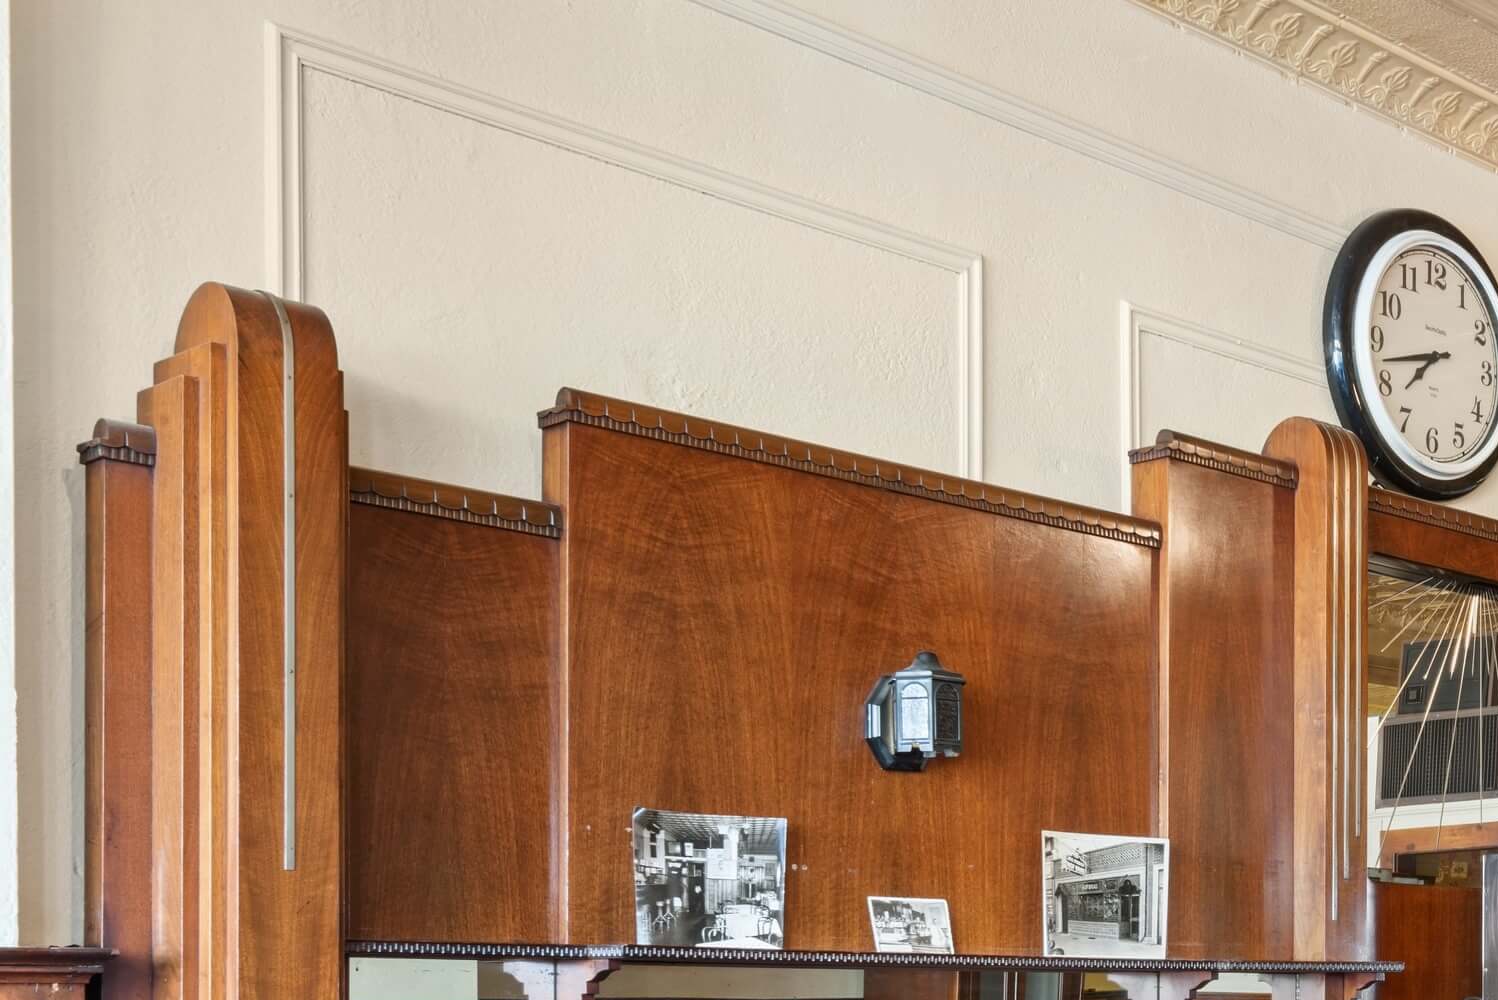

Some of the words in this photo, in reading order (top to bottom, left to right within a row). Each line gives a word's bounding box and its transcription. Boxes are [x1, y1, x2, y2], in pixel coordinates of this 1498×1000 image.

[1399, 263, 1419, 293] 11
[1425, 259, 1447, 291] 12
[1378, 290, 1401, 320] 10
[1457, 284, 1467, 310] 1
[1371, 325, 1384, 352] 9
[1475, 320, 1486, 346] 2
[1379, 370, 1392, 396] 8
[1481, 361, 1492, 386] 3
[1400, 406, 1412, 433] 7
[1471, 397, 1483, 424] 4
[1426, 428, 1438, 453] 6
[1453, 423, 1464, 448] 5
